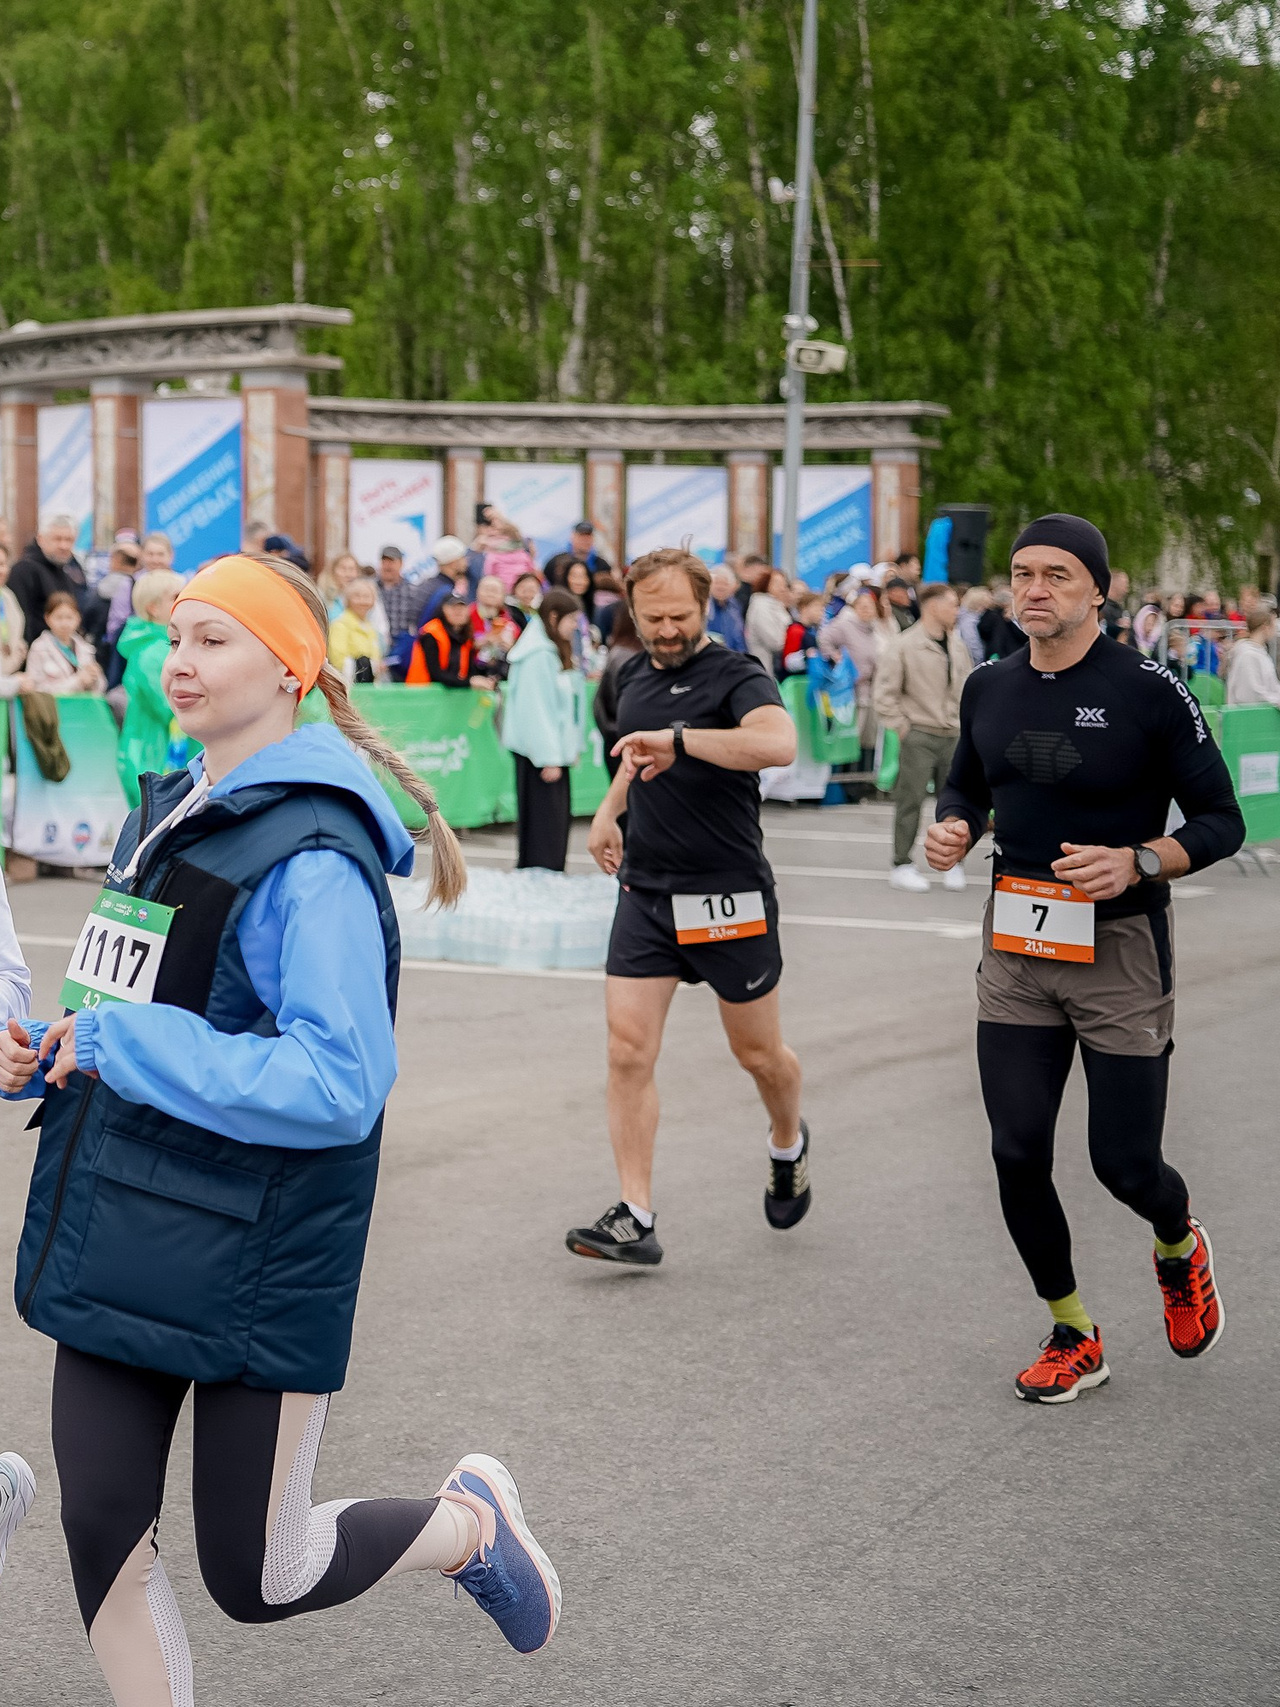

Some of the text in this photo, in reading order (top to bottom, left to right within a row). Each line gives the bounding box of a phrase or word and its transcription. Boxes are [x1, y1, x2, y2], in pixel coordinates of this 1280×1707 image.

[702, 895, 736, 920] 10
[1031, 903, 1049, 932] 7
[79, 925, 151, 989] 1117
